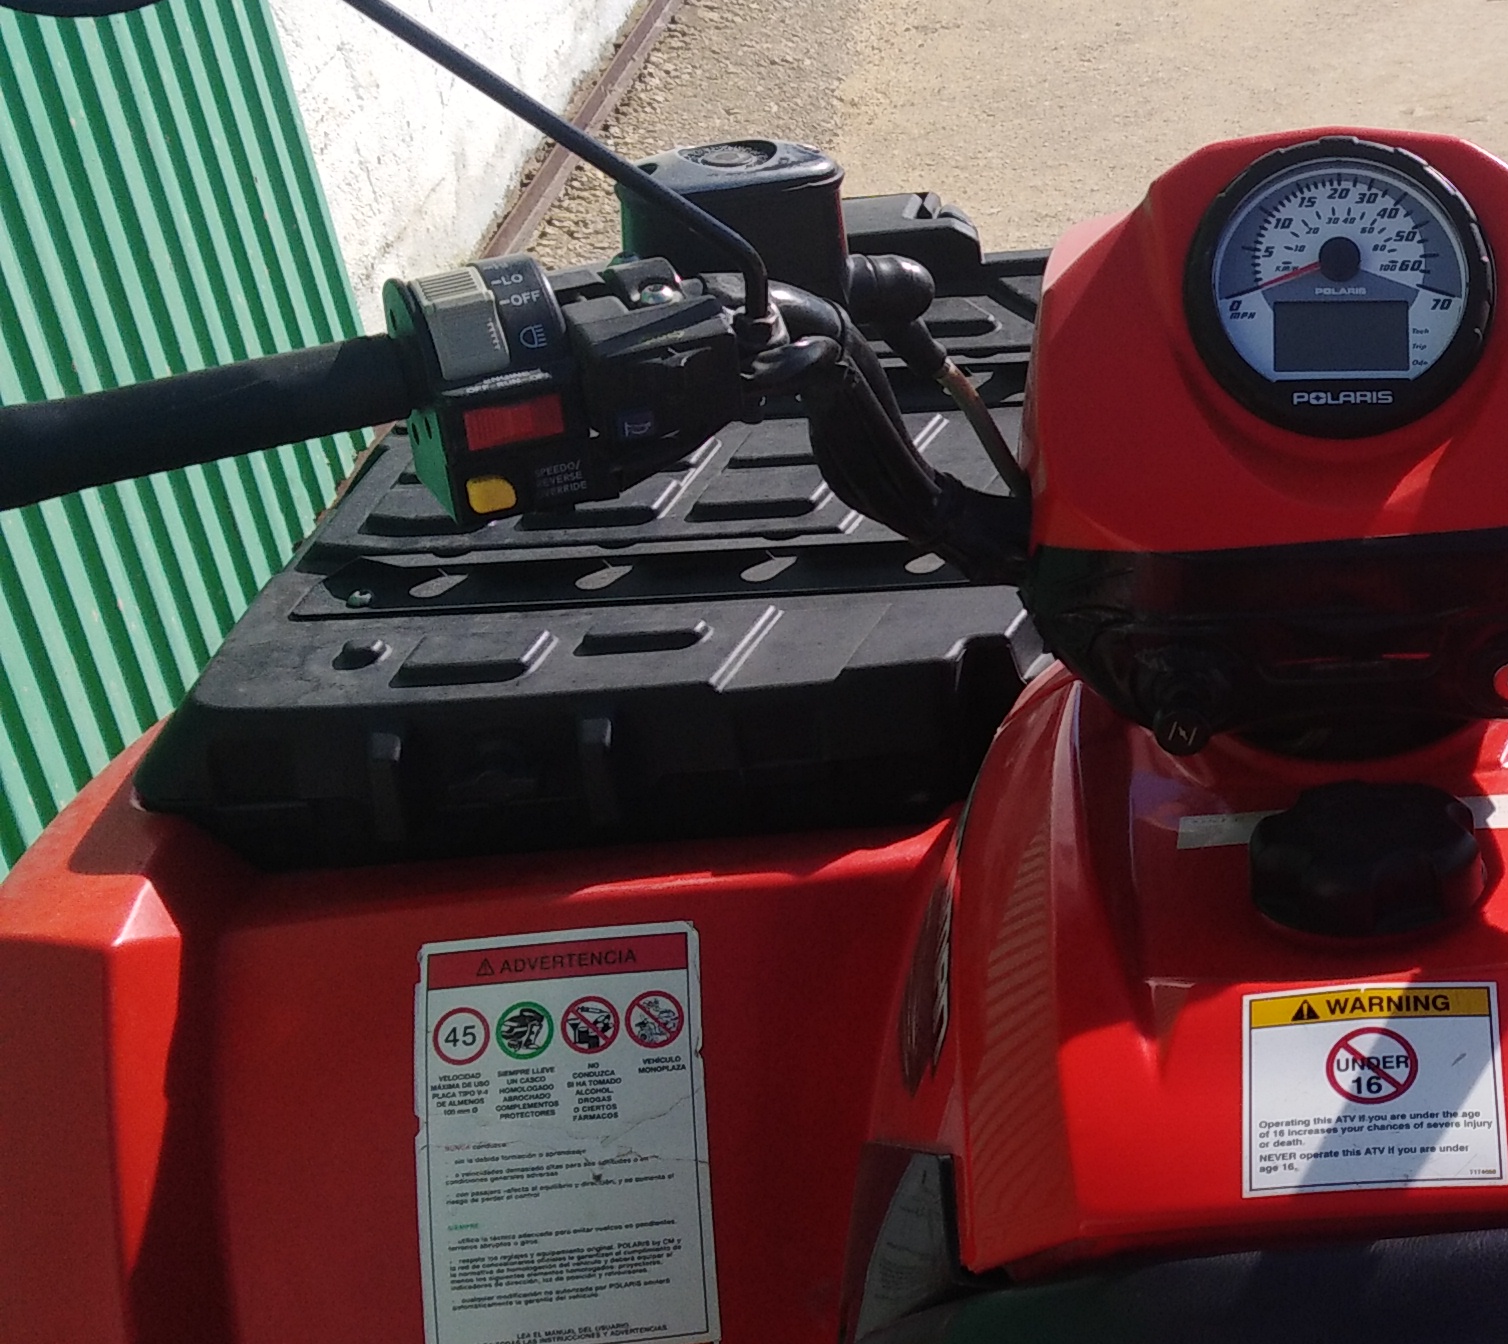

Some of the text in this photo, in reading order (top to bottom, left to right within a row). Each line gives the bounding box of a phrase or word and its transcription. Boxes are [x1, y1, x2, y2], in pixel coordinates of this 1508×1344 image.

[1327, 188, 1350, 199] 20
[1355, 193, 1379, 204] 30
[1298, 197, 1317, 208] 15
[1377, 208, 1399, 219] 40
[1274, 218, 1293, 229] 10
[1394, 231, 1417, 242] 50
[1262, 246, 1275, 258] 5
[1399, 260, 1422, 271] 60
[501, 273, 523, 285] LO
[1315, 287, 1367, 295] POLARIS
[511, 290, 540, 306] OFF
[1229, 300, 1242, 311] 0
[1430, 298, 1452, 310] 70
[1293, 391, 1394, 405] POLARIS
[500, 949, 637, 973] ADVERTENCIA
[1326, 995, 1450, 1014] WARNING
[444, 1025, 477, 1047] 45
[638, 1064, 686, 1074] MONOPLAZA
[1336, 1055, 1410, 1072] UNDER
[439, 1073, 481, 1082] VELOCIDAD
[520, 1076, 546, 1084] CASCO
[572, 1070, 615, 1079] CONDUZCA
[588, 1077, 622, 1086] TOMADO
[1352, 1076, 1383, 1094] 16
[499, 1084, 555, 1094] HOMOLOGADO
[432, 1092, 456, 1100] PLACA
[502, 1092, 551, 1103] ABROCHADO
[578, 1096, 612, 1104] DROGAS
[495, 1100, 560, 1112] COMPLEMENTOS
[582, 1104, 618, 1113] CIERTOS
[499, 1109, 556, 1120] PROTECTORES
[1259, 1119, 1310, 1130] Operating
[1313, 1117, 1332, 1125] this
[1335, 1115, 1356, 1123] ATV
[1368, 1115, 1387, 1123] you
[1409, 1111, 1439, 1119] under
[1443, 1110, 1459, 1118] the
[1462, 1111, 1480, 1119] age
[1259, 1119, 1492, 1138] of 16 increases your chances of severe injury
[1259, 1152, 1296, 1162] NEVER
[1300, 1150, 1339, 1160] operate
[1342, 1149, 1361, 1157] this
[1364, 1147, 1385, 1156] ATV
[1398, 1146, 1417, 1156] you
[1439, 1144, 1469, 1152] under
[1259, 1165, 1279, 1174] age
